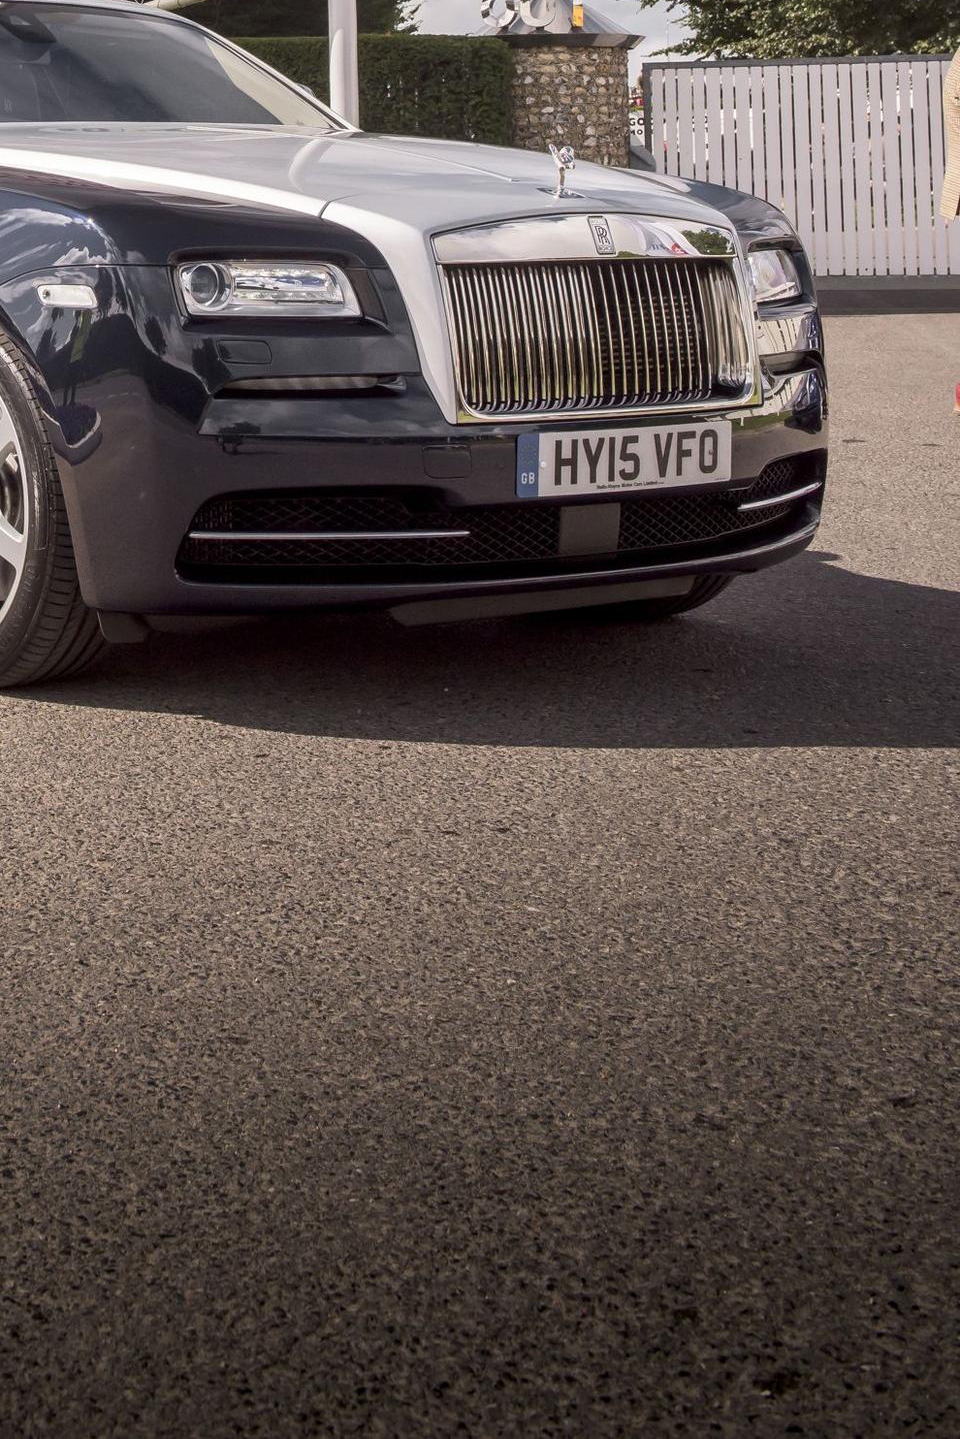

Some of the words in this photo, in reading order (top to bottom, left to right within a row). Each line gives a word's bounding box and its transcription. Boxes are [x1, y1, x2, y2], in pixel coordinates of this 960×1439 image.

[554, 434, 641, 486] HY15
[653, 428, 719, 478] VFO
[521, 472, 536, 484] GB
